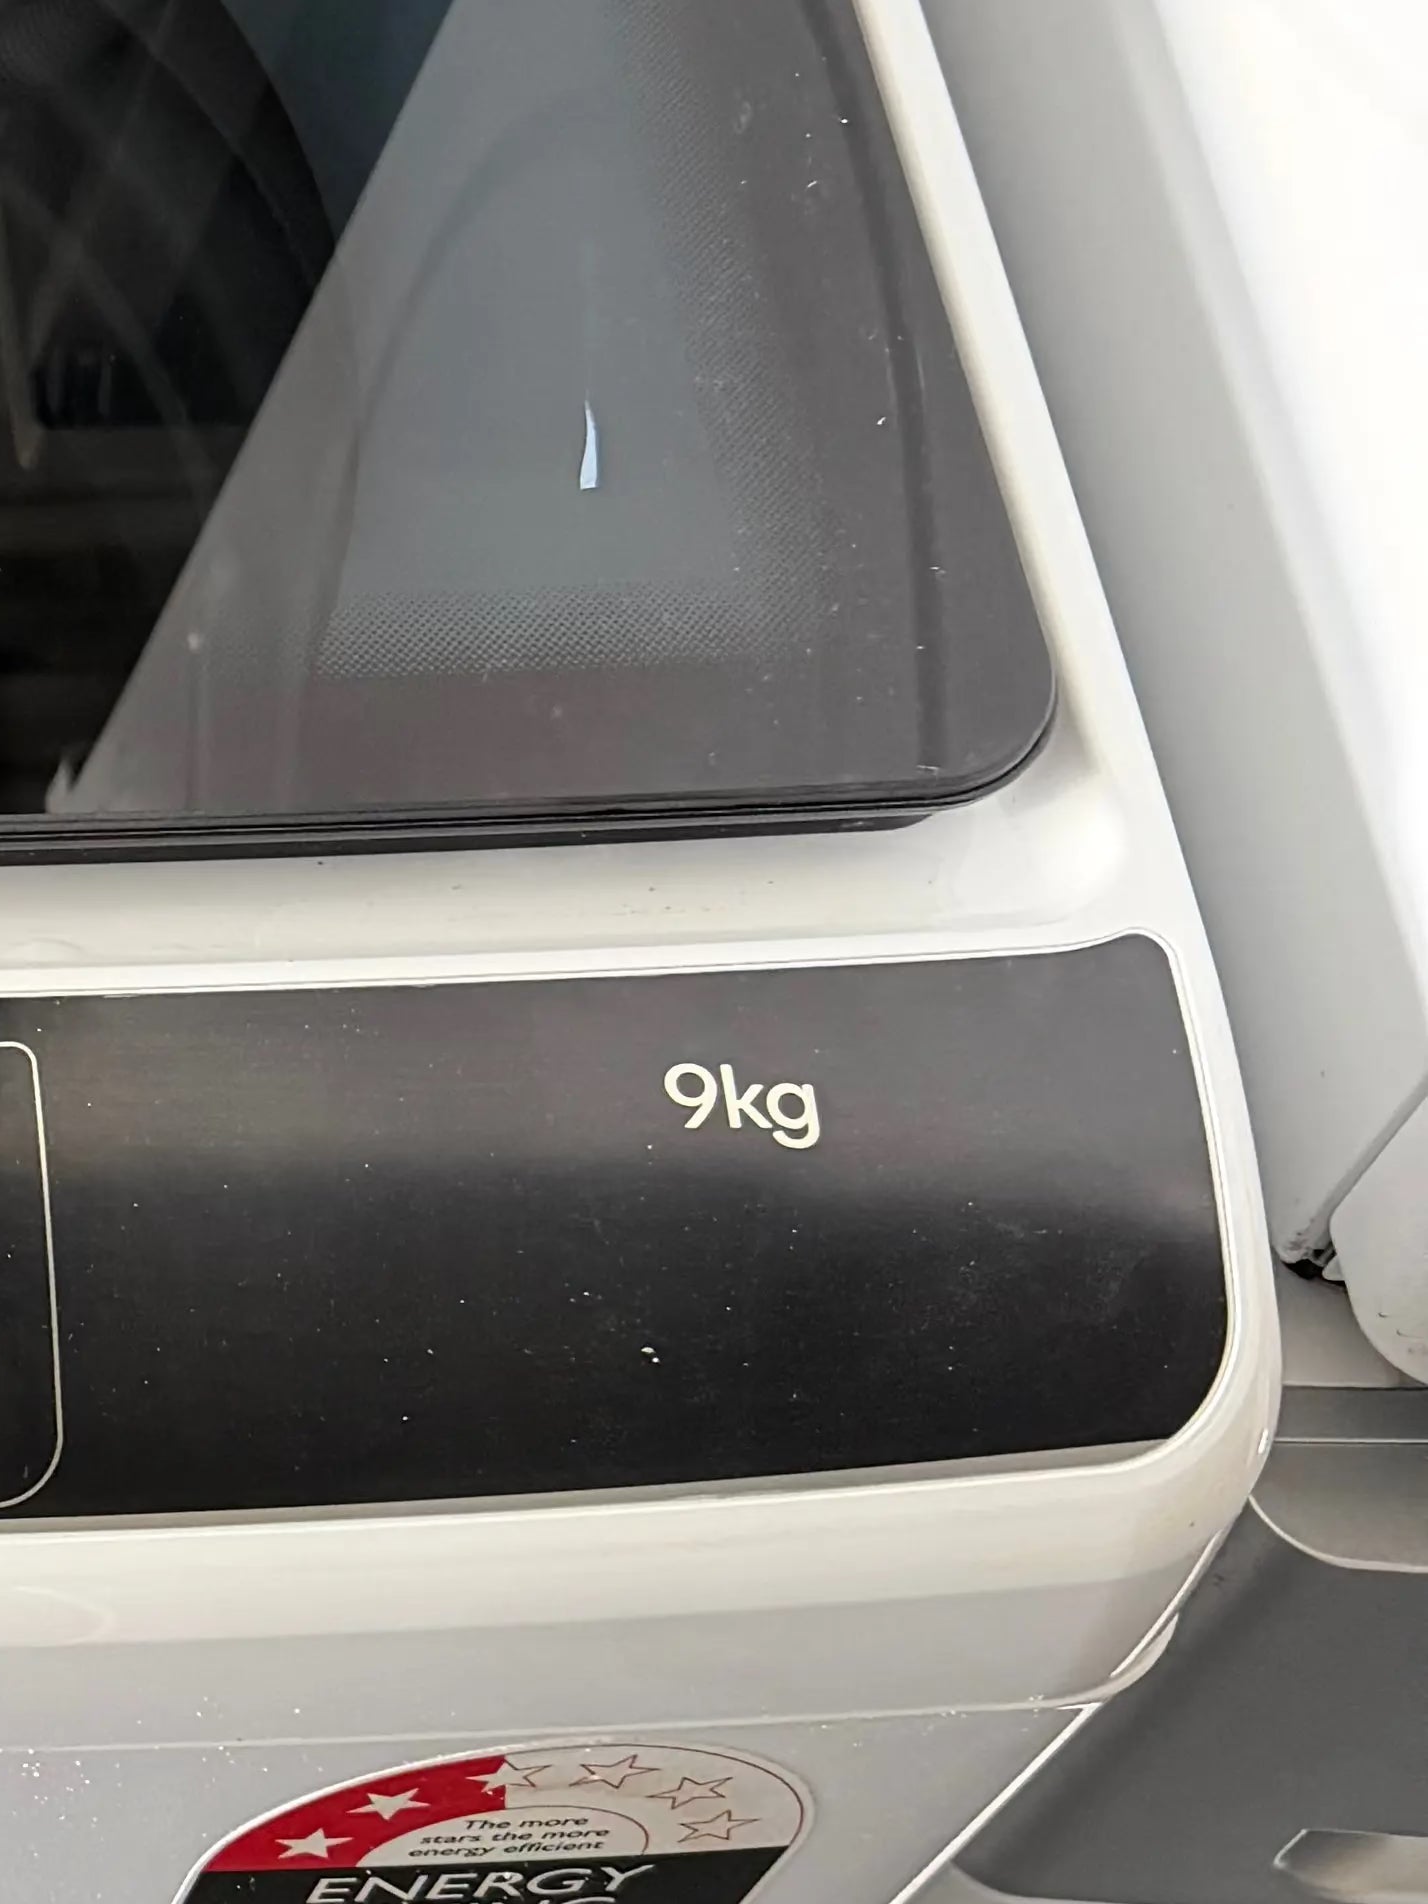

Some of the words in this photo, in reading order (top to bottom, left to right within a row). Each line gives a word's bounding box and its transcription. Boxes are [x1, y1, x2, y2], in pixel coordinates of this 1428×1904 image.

[665, 1063, 820, 1148] 9kg
[465, 1820, 510, 1830] The
[519, 1818, 588, 1828] more
[421, 1834, 482, 1844] stars
[492, 1832, 533, 1841] the
[542, 1829, 610, 1839] more
[409, 1848, 493, 1857] energy
[504, 1842, 604, 1854] efficient
[306, 1864, 655, 1904] ENERGY
